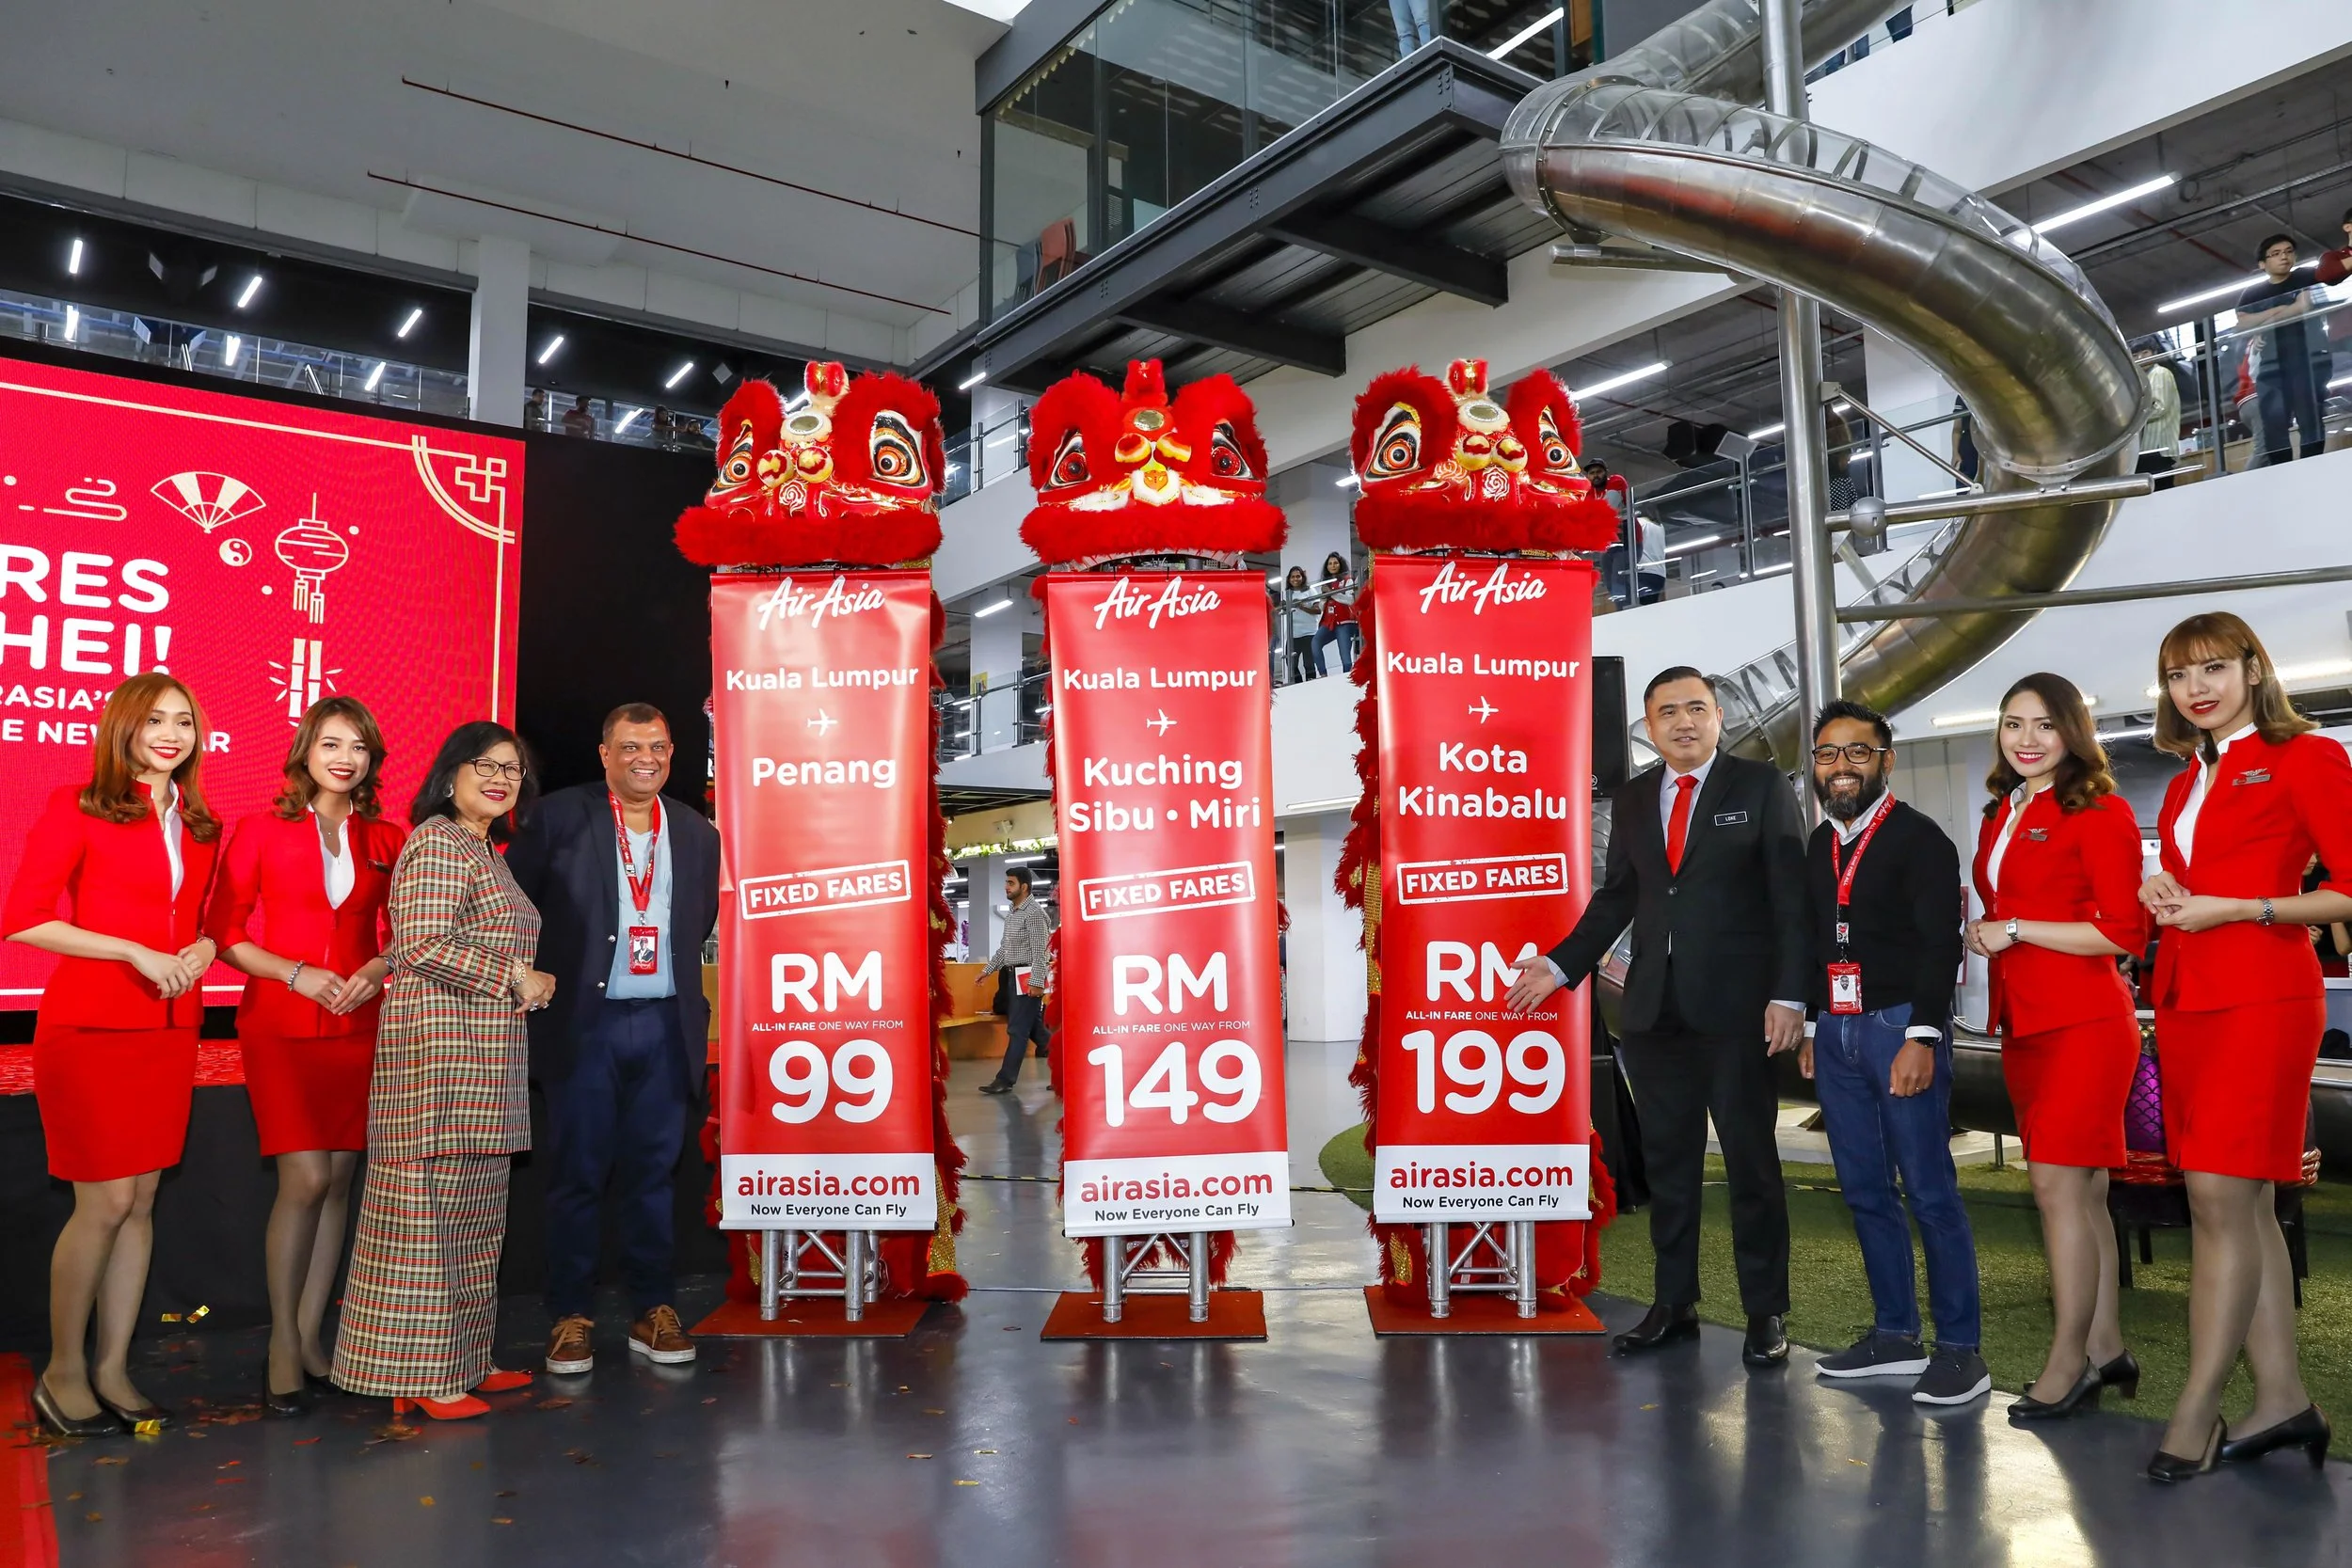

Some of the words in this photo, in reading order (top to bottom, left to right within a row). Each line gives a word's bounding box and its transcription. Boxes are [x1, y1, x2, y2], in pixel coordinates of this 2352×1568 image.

[726, 668, 802, 690] Kuala
[812, 666, 918, 689] Lumpur
[1064, 667, 1140, 690] Kuala
[1151, 667, 1258, 691] Lumpur
[1388, 652, 1463, 674] Kuala
[1474, 654, 1580, 681] Lumpur
[38, 721, 97, 745] NE
[1084, 754, 1243, 789] Kuching
[1439, 742, 1527, 773] Kota
[753, 758, 898, 788] Penang
[1069, 800, 1154, 832] Sibu
[1190, 798, 1260, 829] Miri
[1399, 785, 1565, 819] Kinabalu
[750, 881, 818, 908] FIXED
[827, 872, 903, 897] FARES
[1089, 883, 1162, 910] FIXED
[1169, 873, 1246, 899] FARES
[1406, 870, 1477, 893] FIXED
[1486, 865, 1559, 889] FARES
[771, 951, 882, 1013] RM
[1112, 952, 1228, 1015] RM
[1426, 941, 1537, 1002] RM
[752, 1022, 786, 1032] ALL-IN
[788, 1022, 816, 1031] FARE
[818, 1022, 842, 1030] ONE
[845, 1022, 869, 1030] WAY
[872, 1021, 903, 1029] FROM
[1093, 1024, 1129, 1034] ALL-IN
[1133, 1023, 1160, 1033] FARE
[1164, 1022, 1188, 1032] ONE
[1191, 1022, 1216, 1031] WAY
[1218, 1021, 1250, 1030] FROM
[1406, 1011, 1441, 1020] ALL-IN
[1444, 1011, 1472, 1020] FARE
[1474, 1011, 1499, 1020] ONE
[1528, 1012, 1558, 1021] FROM
[769, 1039, 893, 1124] 99
[1088, 1039, 1262, 1127] 149
[1401, 1030, 1565, 1114] 199
[738, 1170, 919, 1196] airasia.com
[1081, 1173, 1272, 1202] airasia.com
[1390, 1161, 1572, 1188] airasia.com
[751, 1204, 784, 1215] Now
[786, 1204, 850, 1218] Everyone
[854, 1204, 881, 1215] Can
[886, 1204, 906, 1218] Fly
[1095, 1210, 1128, 1222] Now
[1133, 1206, 1200, 1221] Everyone
[1205, 1205, 1232, 1216] Can
[1237, 1203, 1259, 1217] Fly
[1403, 1196, 1434, 1209] Now
[1439, 1196, 1503, 1211] Everyone
[1508, 1196, 1534, 1207] Can
[1539, 1195, 1559, 1209] Fly
